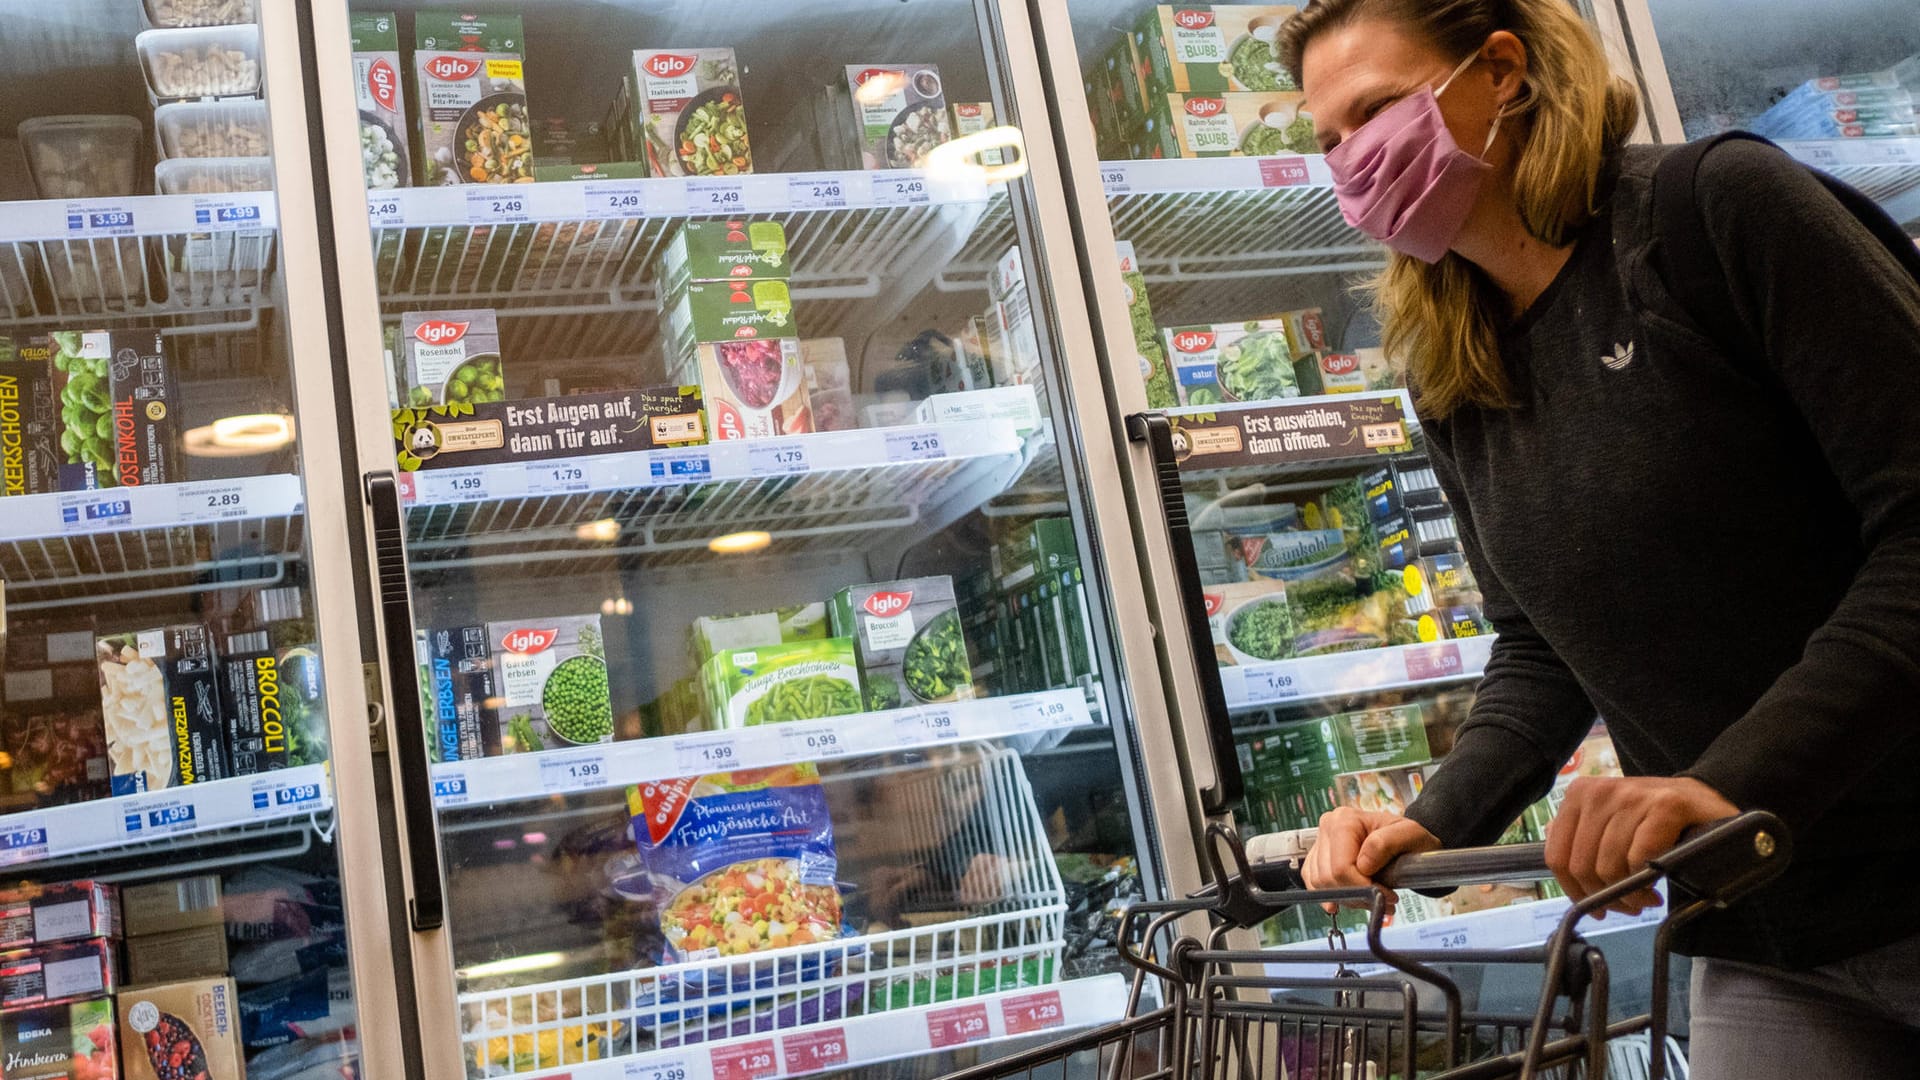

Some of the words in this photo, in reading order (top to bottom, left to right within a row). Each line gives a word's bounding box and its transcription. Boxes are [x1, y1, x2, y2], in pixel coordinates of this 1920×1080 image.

[1181, 13, 1206, 26] iglo
[1185, 44, 1218, 58] BLUBB
[436, 60, 468, 77] iglo
[653, 58, 685, 74] iglo
[373, 67, 391, 99] iglo
[651, 88, 686, 96] Italienisch
[1192, 100, 1217, 114] iglo
[1195, 132, 1229, 146] BLUBB
[1281, 168, 1304, 178] 1.99
[813, 187, 840, 198] 2,49
[896, 182, 923, 194] 2,49
[610, 196, 639, 208] 2,49
[711, 192, 739, 204] 2,49
[222, 207, 255, 219] 4.99
[368, 204, 397, 216] 2,49
[493, 201, 522, 213] 2,49
[96, 213, 128, 225] 3.99
[425, 324, 457, 342] iglo
[1307, 318, 1320, 341] iglo
[1181, 334, 1207, 350] iglo
[420, 347, 462, 357] Rosenkohl
[1328, 357, 1352, 371] iglo
[1192, 369, 1213, 379] natur
[641, 394, 657, 402] Das
[660, 395, 683, 404] spart
[506, 405, 544, 427] Erst
[547, 402, 600, 426] Augen
[604, 396, 637, 420] auf,
[643, 404, 681, 415] Energie!
[1243, 414, 1272, 434] Erst
[1274, 408, 1347, 431] auswählen,
[510, 433, 552, 454] dann
[556, 427, 585, 449] Tür
[590, 424, 623, 447] auf.
[911, 439, 939, 452] 2.19
[1249, 437, 1281, 454] dann
[1283, 433, 1331, 451] öffnen.
[775, 451, 802, 464] 1.79
[553, 469, 582, 481] 1.79
[451, 478, 481, 490] 1.99
[208, 494, 240, 507] 2.89
[92, 502, 125, 517] 1.19
[1264, 535, 1330, 567] Grünkohl
[873, 595, 902, 613] iglo
[870, 620, 899, 631] Broccoli
[512, 631, 545, 650] iglo
[507, 668, 537, 678] erbsen
[744, 673, 774, 693] Junge
[777, 660, 841, 683] Brechbohnen
[433, 658, 456, 720] ERBSEN
[1267, 676, 1292, 689] 1,69
[256, 656, 285, 753] BROCCOLI
[1038, 702, 1064, 717] 1,89
[807, 734, 837, 748] 0,99
[702, 747, 732, 761] 1.99
[569, 763, 600, 777] 1.99
[281, 786, 315, 802] 0,99
[154, 807, 189, 824] 1,99
[693, 798, 783, 820] Pfannengemüse
[678, 815, 781, 847] Französische
[780, 806, 812, 827] Art
[5, 830, 41, 846] 1.79
[1442, 935, 1466, 948] 2,49
[213, 985, 228, 1038] BEEREN-
[1028, 1006, 1058, 1020] 1.29
[954, 1018, 984, 1033] 1,29
[18, 1028, 52, 1040] EDEKA
[810, 1043, 841, 1058] 1.29
[5, 1051, 69, 1072] Himbeeren
[739, 1055, 770, 1069] 1.29
